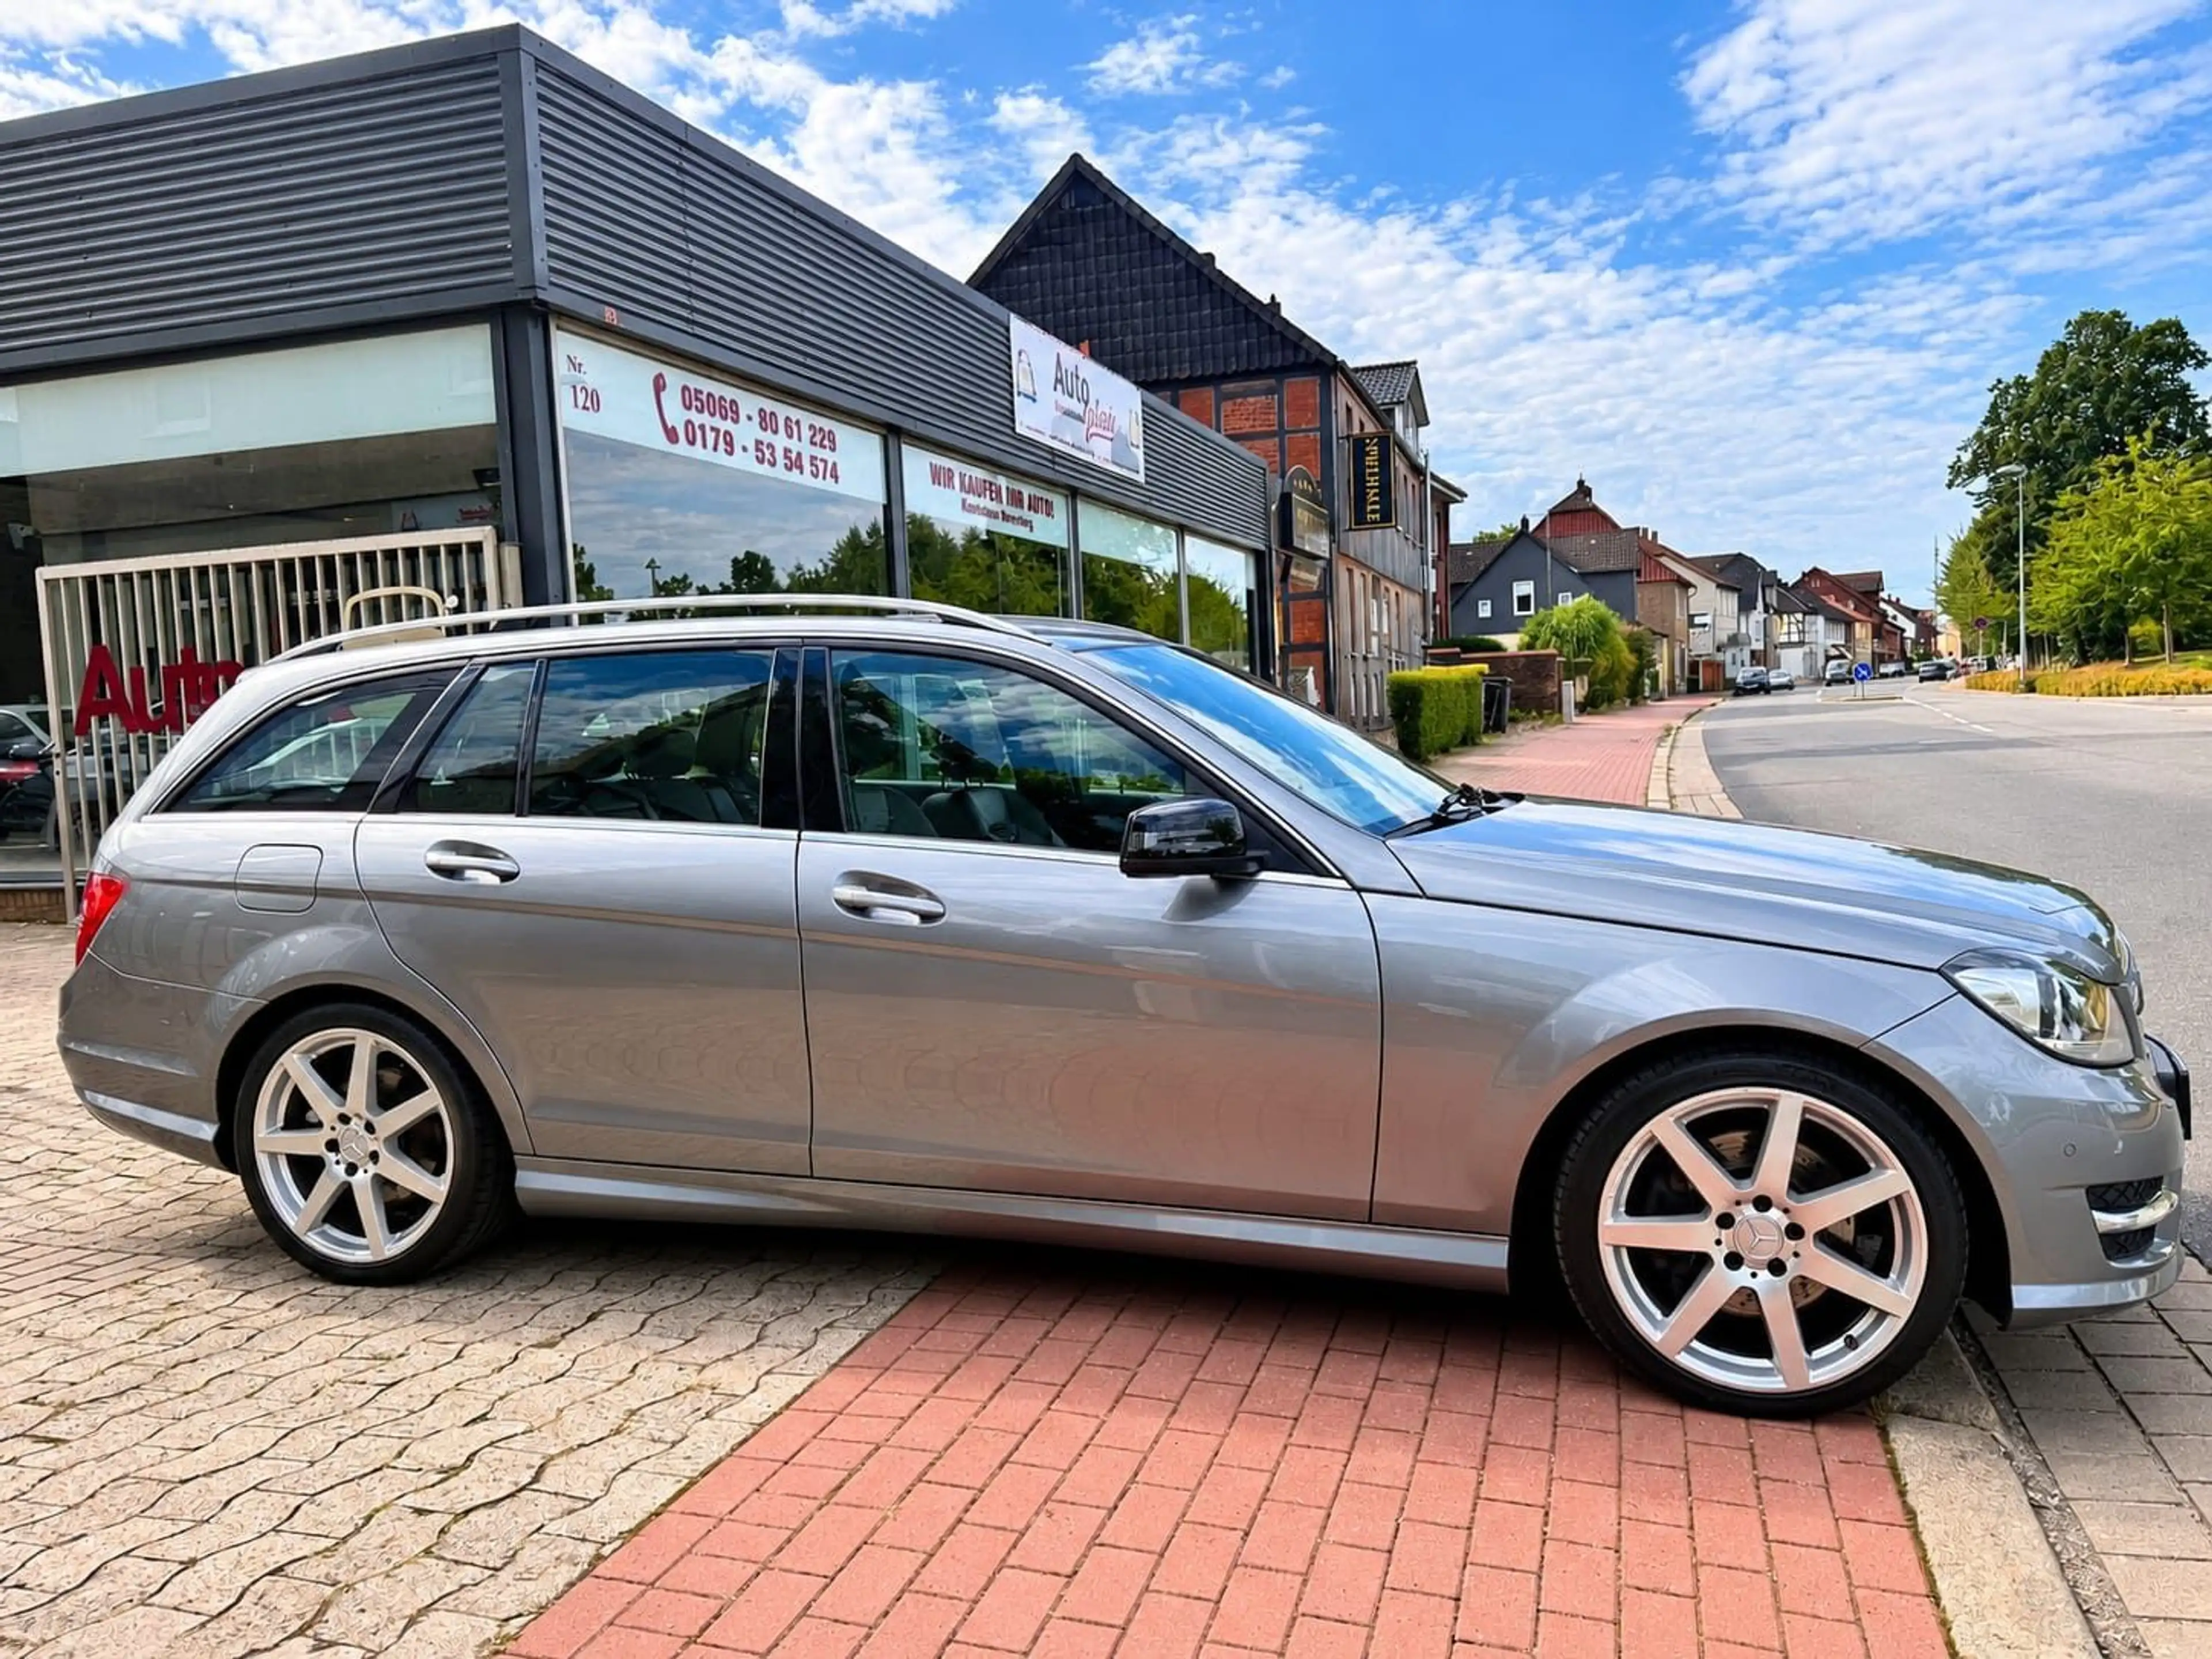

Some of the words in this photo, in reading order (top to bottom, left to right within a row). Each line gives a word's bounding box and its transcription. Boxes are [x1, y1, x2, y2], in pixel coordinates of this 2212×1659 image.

[566, 354, 587, 375] Nr.
[1054, 352, 1089, 405] Auto
[570, 384, 600, 413] 120
[681, 384, 740, 425] 05069
[757, 407, 779, 435] 80
[784, 415, 803, 442] 61
[808, 423, 836, 453] 229
[684, 419, 734, 456] 0179
[754, 439, 777, 468] 53
[783, 448, 804, 476] 54
[809, 456, 839, 484] 574
[929, 461, 955, 490] WIR
